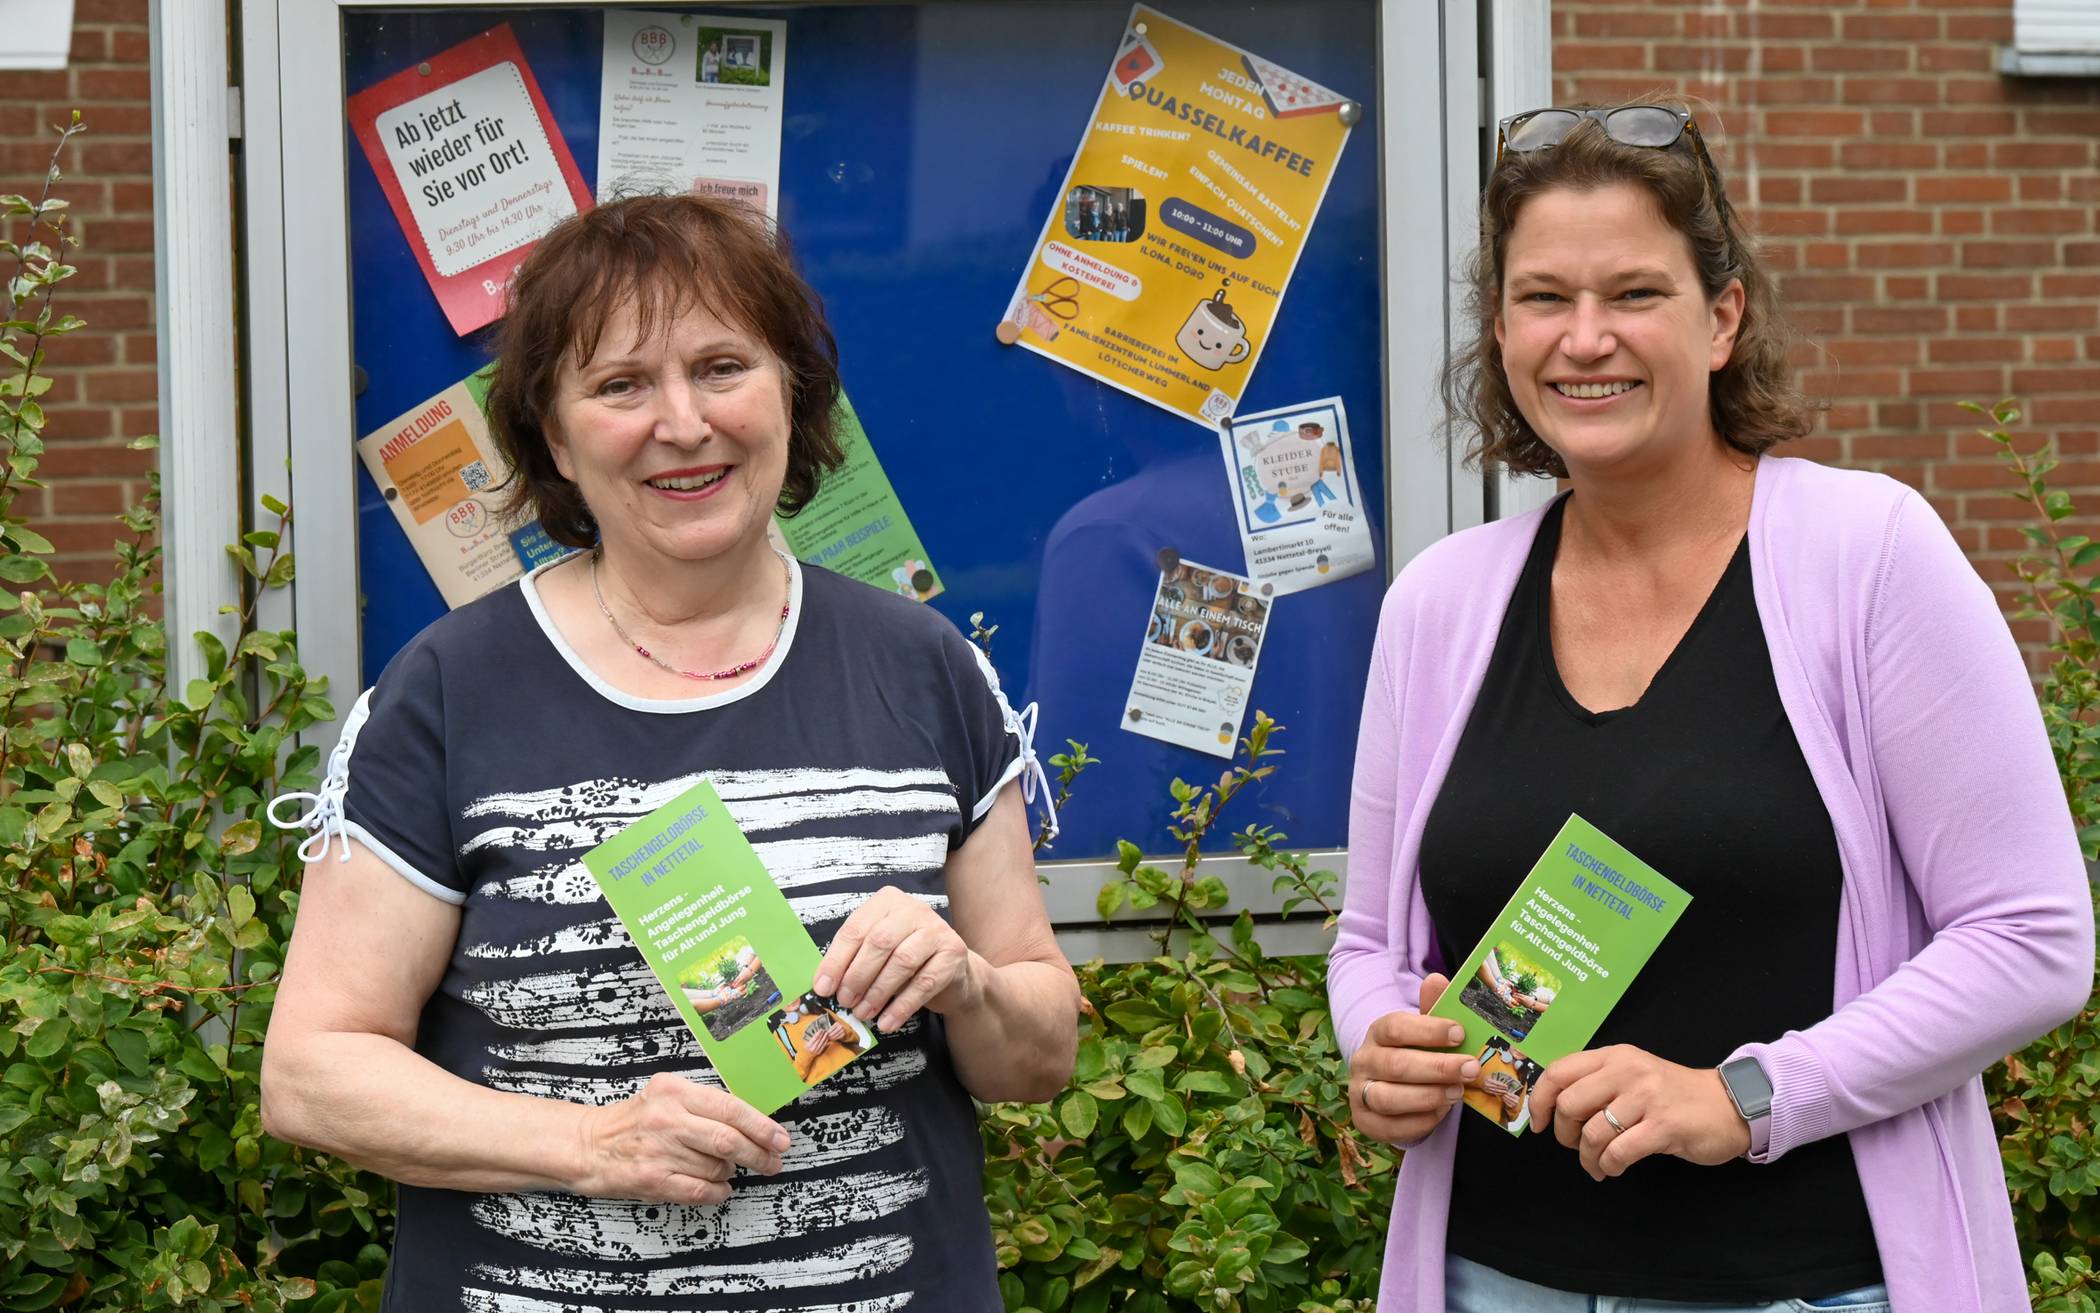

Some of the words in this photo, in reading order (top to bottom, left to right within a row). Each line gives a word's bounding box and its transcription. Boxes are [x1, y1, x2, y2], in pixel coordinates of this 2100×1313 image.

[1200, 82, 1265, 120] MONTAG
[1218, 68, 1264, 96] JEDEN
[395, 121, 421, 149] Ab
[419, 99, 467, 141] jetzt
[409, 134, 472, 177] wieder
[474, 117, 504, 146] für
[1095, 121, 1136, 134] KAFFEE
[1140, 127, 1191, 142] TRINKEN?
[1128, 80, 1315, 177] QUASSELKAFFEE
[423, 179, 455, 207] Sie
[455, 161, 487, 191] vor
[489, 140, 529, 175] Ort!
[1121, 155, 1168, 181] SPIELEN?
[1208, 150, 1258, 196] GEMEINSAM
[1257, 192, 1301, 232] BASTELN?
[439, 216, 480, 241] Dienstags
[482, 203, 498, 219] und
[501, 180, 553, 211] Donnerstags
[467, 230, 485, 248] Uhr
[486, 224, 500, 237] bis
[526, 204, 544, 219] Uhr
[1171, 208, 1195, 225] 10:00
[1203, 223, 1224, 239] 11:00
[1225, 233, 1244, 247] UHR
[1189, 165, 1229, 200] EINFACH
[1227, 198, 1284, 247] QUATSCHEN?
[1049, 242, 1073, 258] OHNE
[1074, 254, 1130, 283] ANMELDUNG
[1061, 262, 1115, 291] KOSTENFREI
[1147, 232, 1167, 247] WIR
[1207, 262, 1227, 275] UNS
[1229, 272, 1250, 284] AUF
[1251, 281, 1280, 298] EUCH
[1176, 262, 1205, 280] DORO
[1064, 323, 1148, 363] FAMILIENZENTRUM
[1148, 360, 1211, 391] LUMMERLAND
[1105, 326, 1166, 359] BARRIEREFREI
[1168, 355, 1179, 364] IM
[378, 400, 452, 464] ANMELDUNG
[1263, 450, 1312, 465] KLEIDER
[1272, 464, 1308, 478] STUBE
[451, 502, 475, 524] BBB
[1322, 510, 1337, 519] Für
[1324, 524, 1350, 533] offen!
[1158, 596, 1181, 609] ALLE
[1184, 605, 1198, 614] AN
[1200, 608, 1230, 624] EINEM
[1234, 617, 1262, 633] TISCH
[608, 805, 709, 881] TASCHENGELDBÖRSE
[641, 872, 656, 887] IN
[653, 838, 704, 878] NETTETAL
[1566, 843, 1667, 913] TASCHENGELDBÖRSE
[1572, 874, 1584, 889] IN
[1584, 882, 1634, 921] NETTETAL
[638, 894, 684, 926] Herzens
[647, 885, 725, 938] Angelegenheit
[653, 886, 752, 950] Taschengeldbörse
[1526, 898, 1600, 955] Angelegenheit
[1534, 886, 1576, 921] Herzens
[662, 950, 679, 963] für
[679, 938, 697, 953] Alt
[696, 924, 718, 942] und
[719, 907, 747, 928] Jung
[1510, 920, 1527, 935] für
[1526, 932, 1542, 948] Alt
[1541, 944, 1563, 961] und
[1561, 959, 1589, 982] Jung
[1519, 909, 1610, 978] Taschengeldbörse
